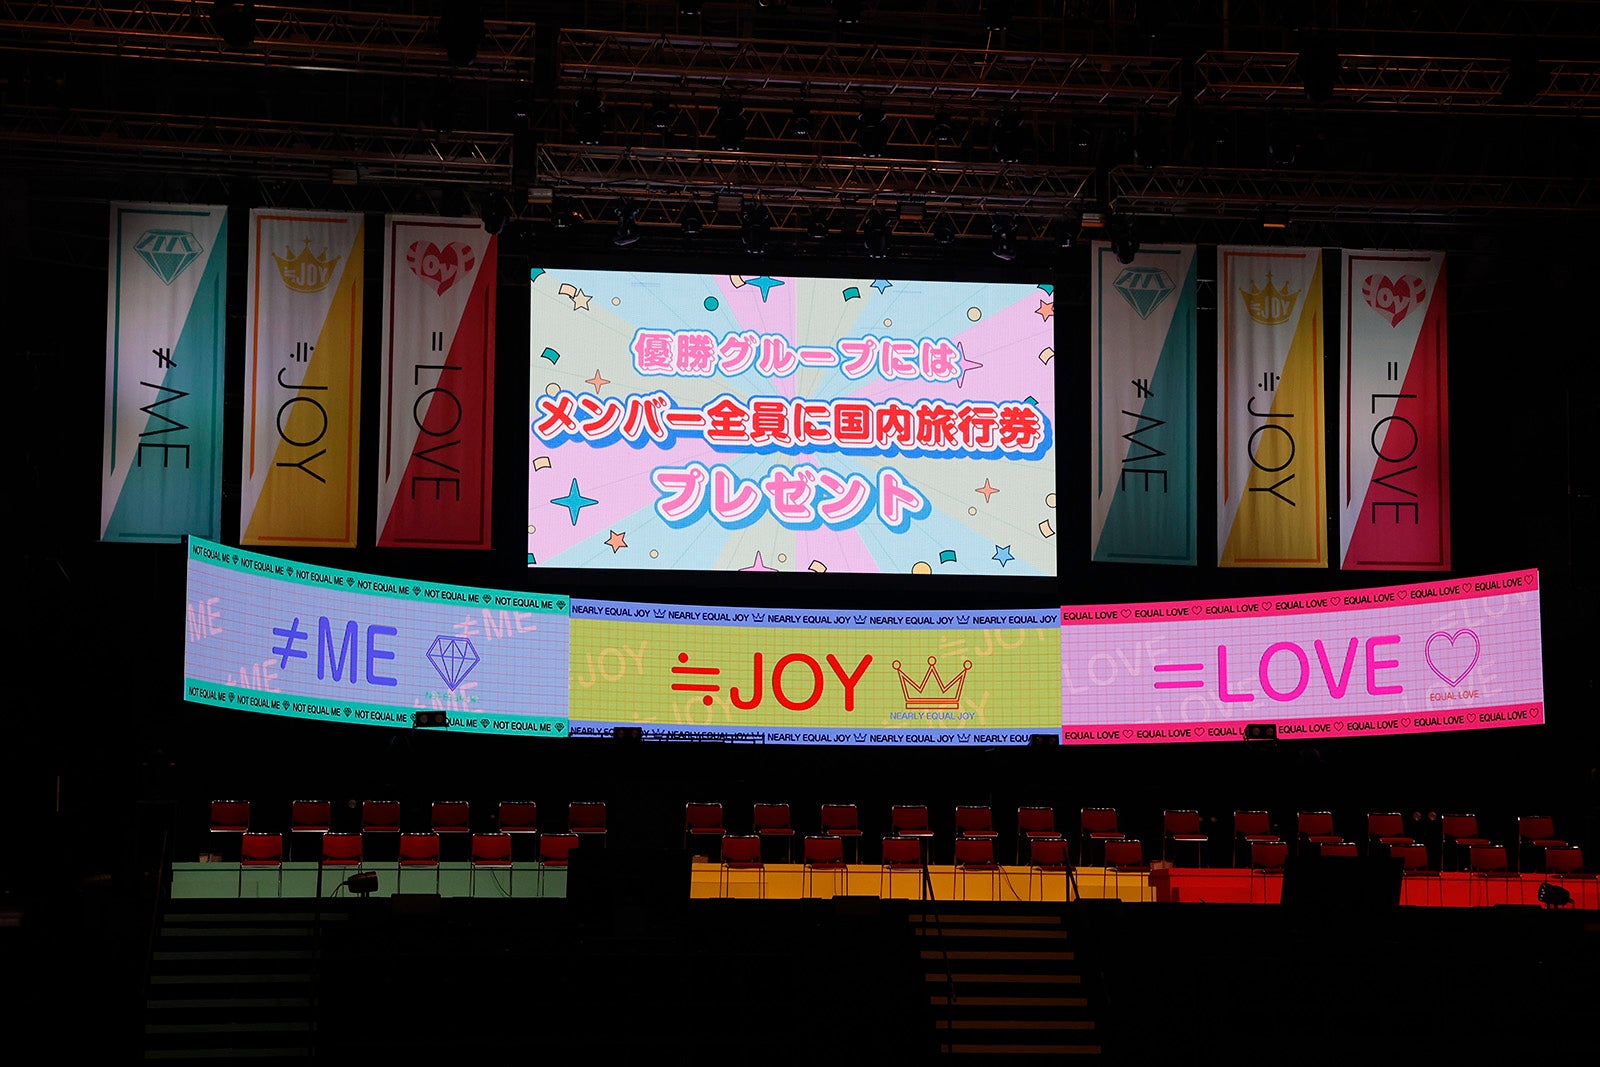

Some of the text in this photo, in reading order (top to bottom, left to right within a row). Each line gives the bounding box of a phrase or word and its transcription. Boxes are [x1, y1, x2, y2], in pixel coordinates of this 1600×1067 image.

[633, 330, 961, 381] 優勝グループには
[535, 393, 1046, 453] メンバー全員に国内旅行券
[653, 463, 930, 528] プレゼント
[193, 545, 552, 609] NOT EQUAL ME NOT EQUAL ME NOT EQUAL ME NOT EQUAL ME NOT EQUAL ME NOT EQUAL ME
[1096, 611, 1117, 619] LOVE
[1167, 608, 1188, 616] LOVE
[1206, 606, 1234, 614] EQUAL
[1237, 604, 1258, 612] LOVE
[1276, 602, 1304, 610] EQUAL
[1306, 599, 1327, 608] LOVE
[1344, 596, 1371, 604] EQUAL
[1374, 593, 1394, 602] LOVE
[1411, 589, 1437, 598] EQUAL
[1440, 586, 1459, 595] LOVE
[1475, 582, 1500, 591] EQUAL
[1503, 578, 1522, 588] LOVE
[572, 606, 603, 614] NEARLY
[605, 608, 632, 616] EQUAL
[634, 609, 650, 617] JOY
[669, 611, 700, 620] NEARLY
[703, 613, 731, 621] EQUAL
[768, 615, 801, 623] NEARLY
[834, 616, 851, 624] JOY
[973, 616, 1006, 624] NEARLY
[1009, 616, 1038, 624] EQUAL
[1040, 615, 1057, 623] JOY
[272, 616, 398, 687] ≠ME
[1153, 634, 1404, 702] =LOVE
[189, 687, 199, 696] NOT
[198, 688, 217, 700] EQUAL
[216, 692, 225, 701] ME
[237, 695, 249, 704] NOT
[250, 697, 270, 708] EQUAL
[271, 700, 280, 709] ME
[293, 703, 306, 712] NOT
[307, 705, 329, 715] EQUAL
[331, 708, 340, 716] ME
[355, 710, 369, 718] NOT
[371, 712, 394, 721] EQUAL
[396, 714, 407, 722] ME
[466, 719, 477, 727] ME
[494, 721, 509, 729] NOT
[511, 722, 538, 731] EQUAL
[890, 712, 976, 721] NEARLY EQUAL JOY
[1430, 690, 1479, 701] EQUAL LOVE
[768, 733, 801, 741] NEARLY
[803, 734, 832, 742] EQUAL
[834, 734, 851, 742] JOY
[1097, 731, 1119, 739] LOVE
[1137, 730, 1165, 738] EQUAL
[1169, 729, 1190, 737] LOVE
[1209, 728, 1237, 736] EQUAL
[1310, 724, 1330, 732] LOVE
[1348, 722, 1375, 730] EQUAL
[1378, 720, 1398, 728] LOVE
[1414, 718, 1441, 726] EQUAL
[1444, 716, 1464, 724] LOVE
[1480, 713, 1505, 722] EQUAL
[1508, 711, 1527, 720] LOVE
